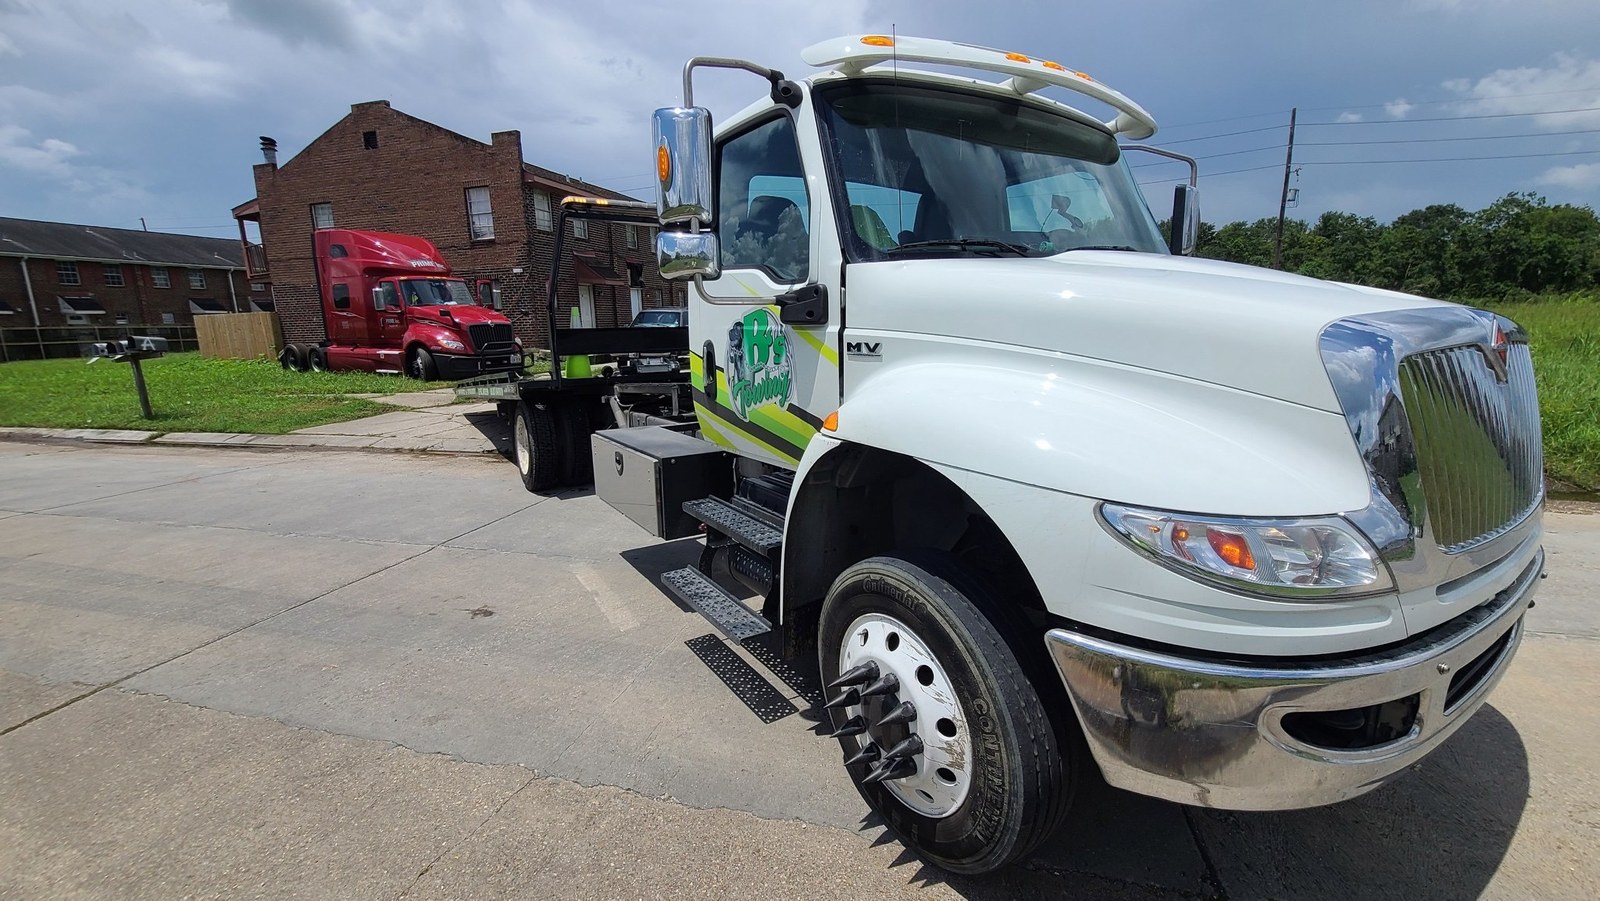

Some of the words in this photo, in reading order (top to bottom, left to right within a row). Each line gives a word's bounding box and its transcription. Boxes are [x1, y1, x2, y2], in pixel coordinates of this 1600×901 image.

[411, 260, 435, 268] PRIME
[141, 336, 156, 351] A
[743, 308, 787, 373] B's
[846, 342, 881, 353] MV
[733, 368, 791, 420] Towing
[862, 574, 919, 611] Continental
